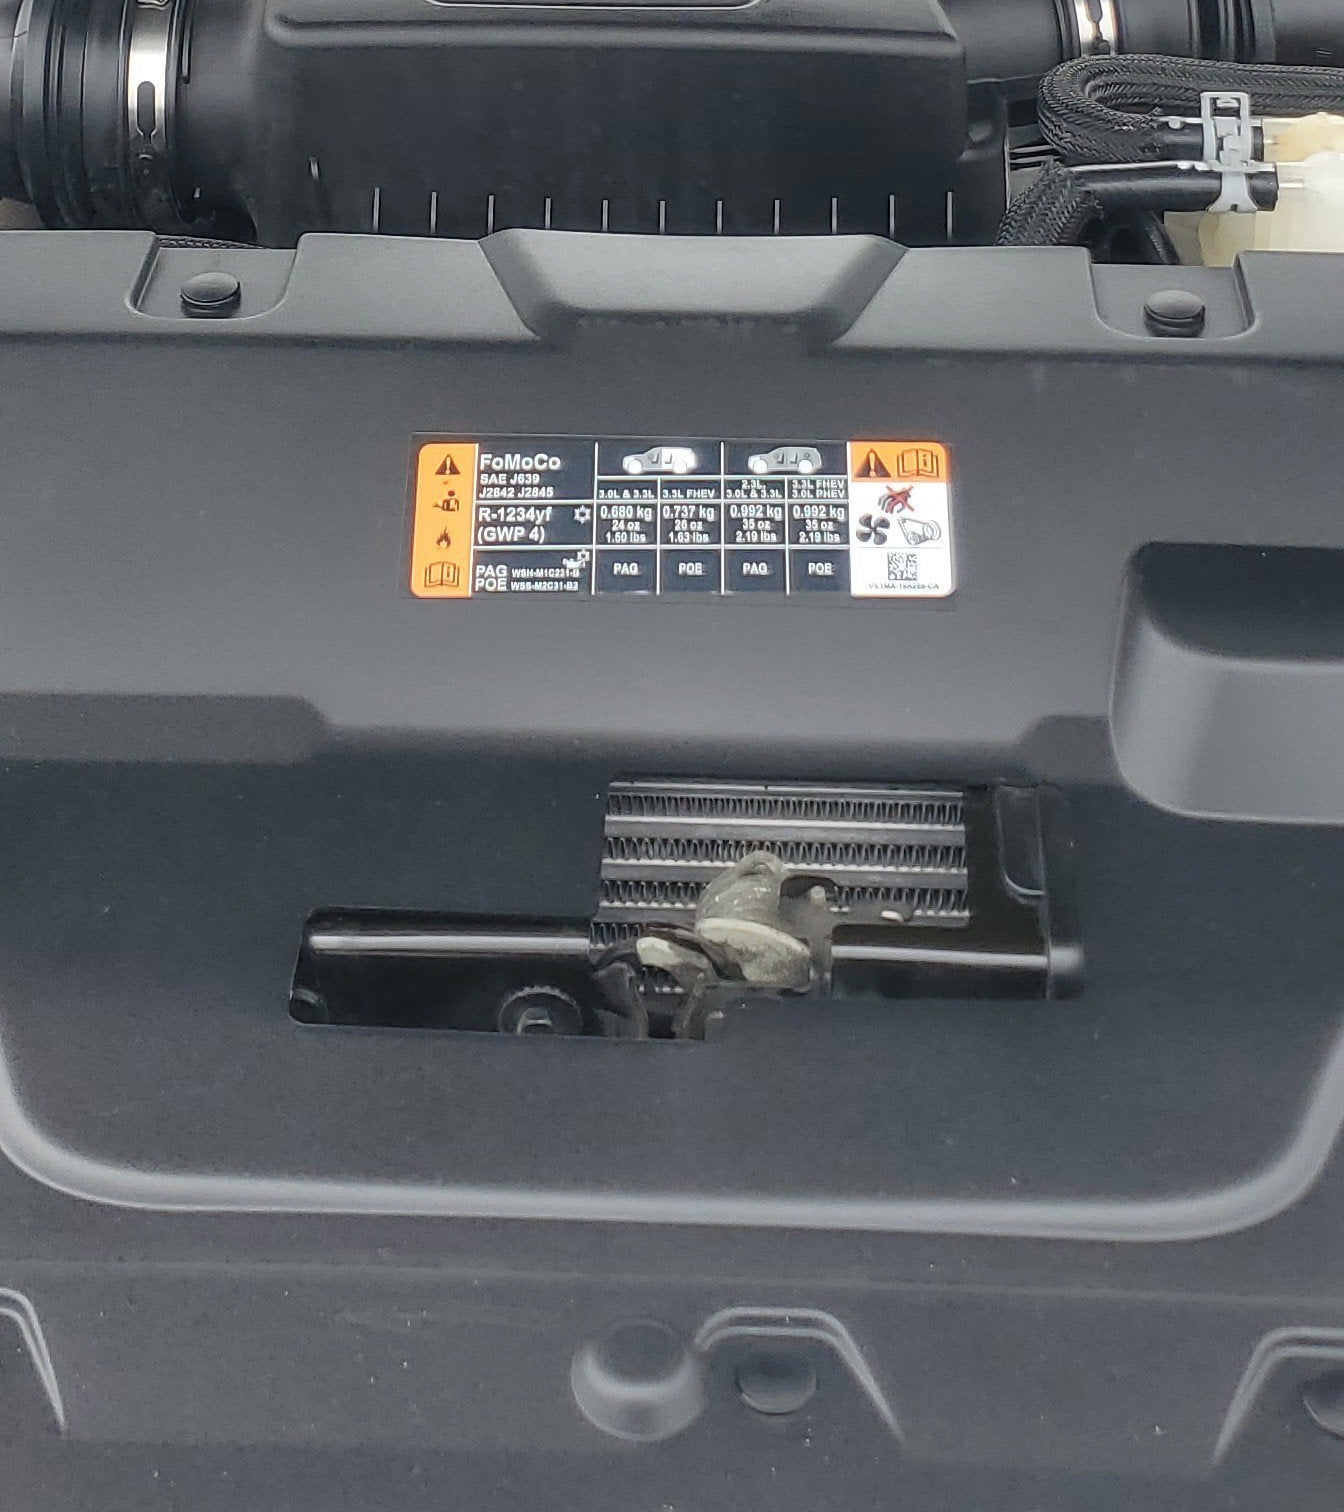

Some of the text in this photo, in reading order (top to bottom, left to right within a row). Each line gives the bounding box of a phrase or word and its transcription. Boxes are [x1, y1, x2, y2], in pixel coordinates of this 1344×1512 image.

[479, 453, 561, 471] FoMoCo
[479, 473, 541, 485] SAE J639
[816, 479, 846, 489] FHEV
[598, 489, 621, 499] 3.0L
[633, 489, 655, 499] 3.3L
[662, 489, 716, 499] 3.3L FHEV
[726, 489, 783, 499] 3.0L & 3.3L
[478, 506, 553, 525] R-1234yf
[600, 504, 653, 522] 0.680 kg
[662, 504, 715, 522] 0.737 kg
[729, 504, 783, 522] 0.992 kg
[792, 504, 846, 522] 0.992 kg
[612, 519, 641, 532] 24 oz
[689, 521, 703, 532] oz
[742, 518, 771, 530] 35 oz
[805, 519, 834, 531] 35 oz
[477, 526, 546, 544] (GWP 4)
[629, 531, 647, 544] lbs
[692, 531, 709, 544] lbs
[760, 530, 777, 543] lbs
[823, 531, 840, 543] lbs
[475, 564, 508, 578] PAG
[613, 562, 639, 576] PAG
[678, 562, 704, 576] POE
[742, 562, 769, 576] PAG
[808, 562, 834, 576] POE
[474, 577, 508, 592] POE
